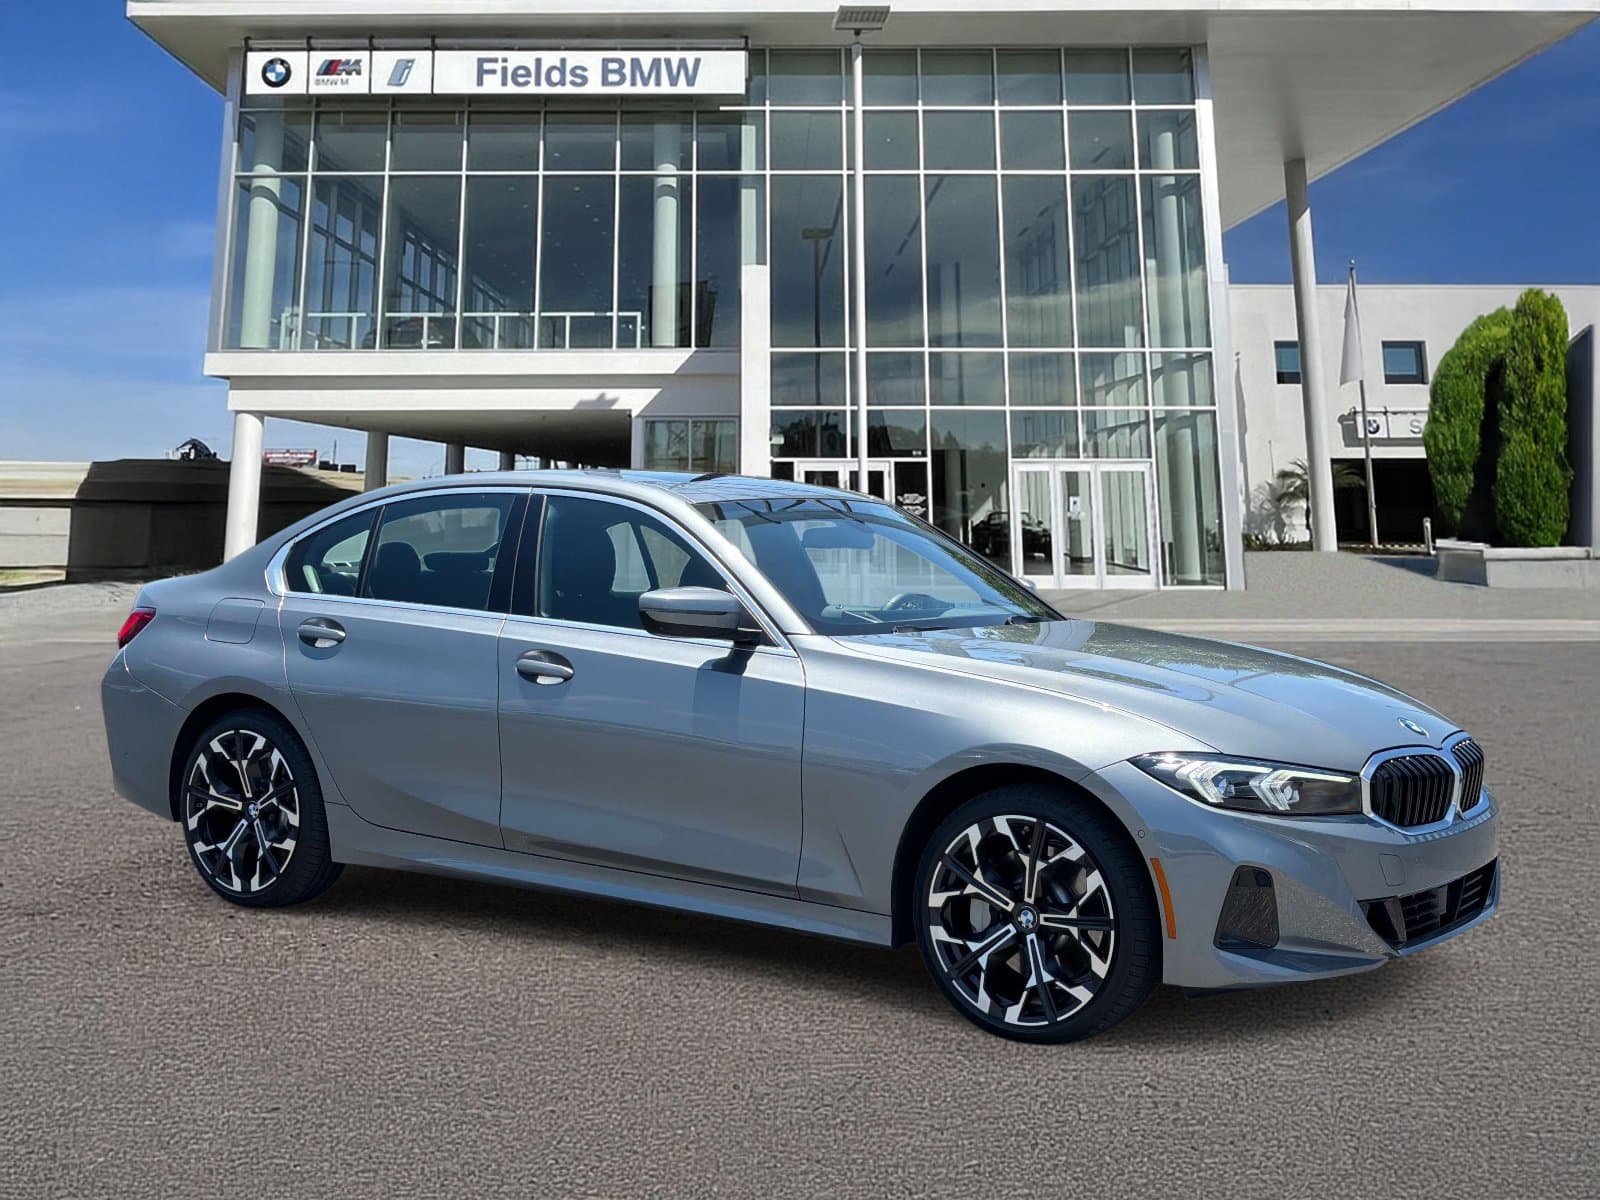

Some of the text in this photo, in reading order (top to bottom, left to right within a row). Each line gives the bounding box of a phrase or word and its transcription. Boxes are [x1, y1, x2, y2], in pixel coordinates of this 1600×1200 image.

[476, 57, 702, 87] Fields BMW
[315, 78, 349, 86] BMW M
